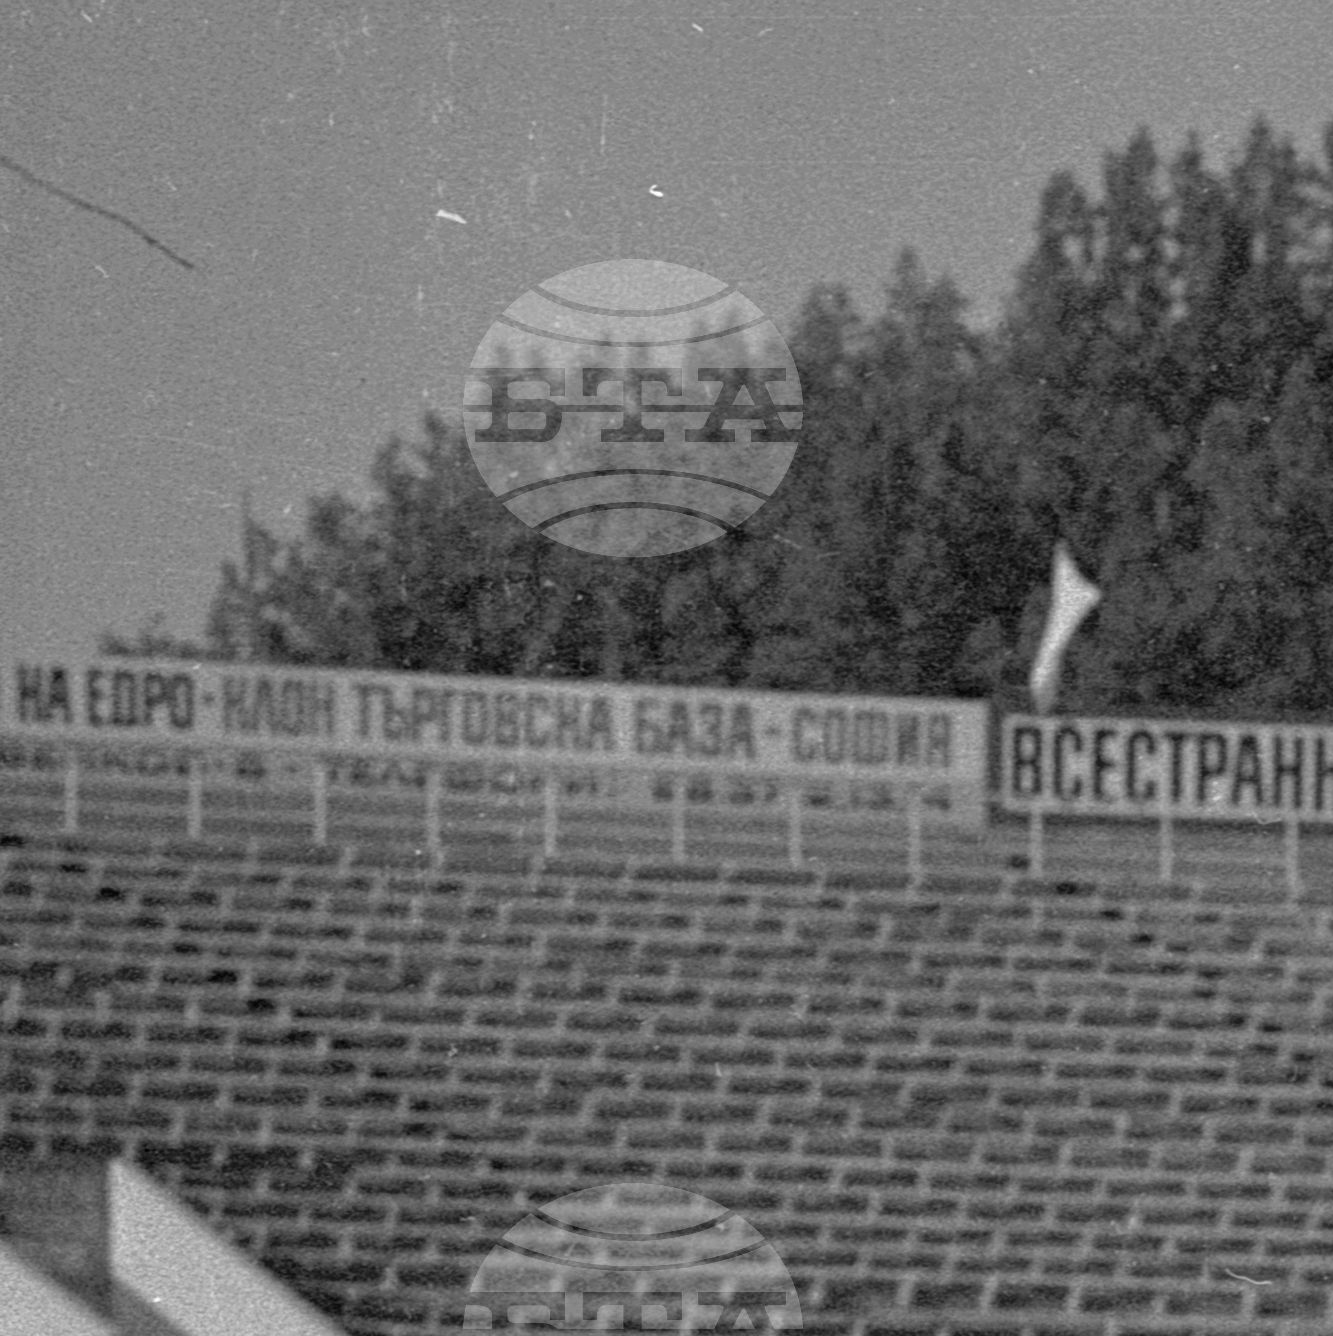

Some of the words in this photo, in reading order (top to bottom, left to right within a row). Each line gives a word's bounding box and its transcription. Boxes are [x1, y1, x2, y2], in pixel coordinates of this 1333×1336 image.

[16, 667, 73, 724] НА
[86, 668, 196, 730] ЕДРО
[354, 682, 613, 753] ТЪРГОВСКА
[634, 699, 756, 762] БАЗА
[790, 707, 953, 768] СОФИЯ
